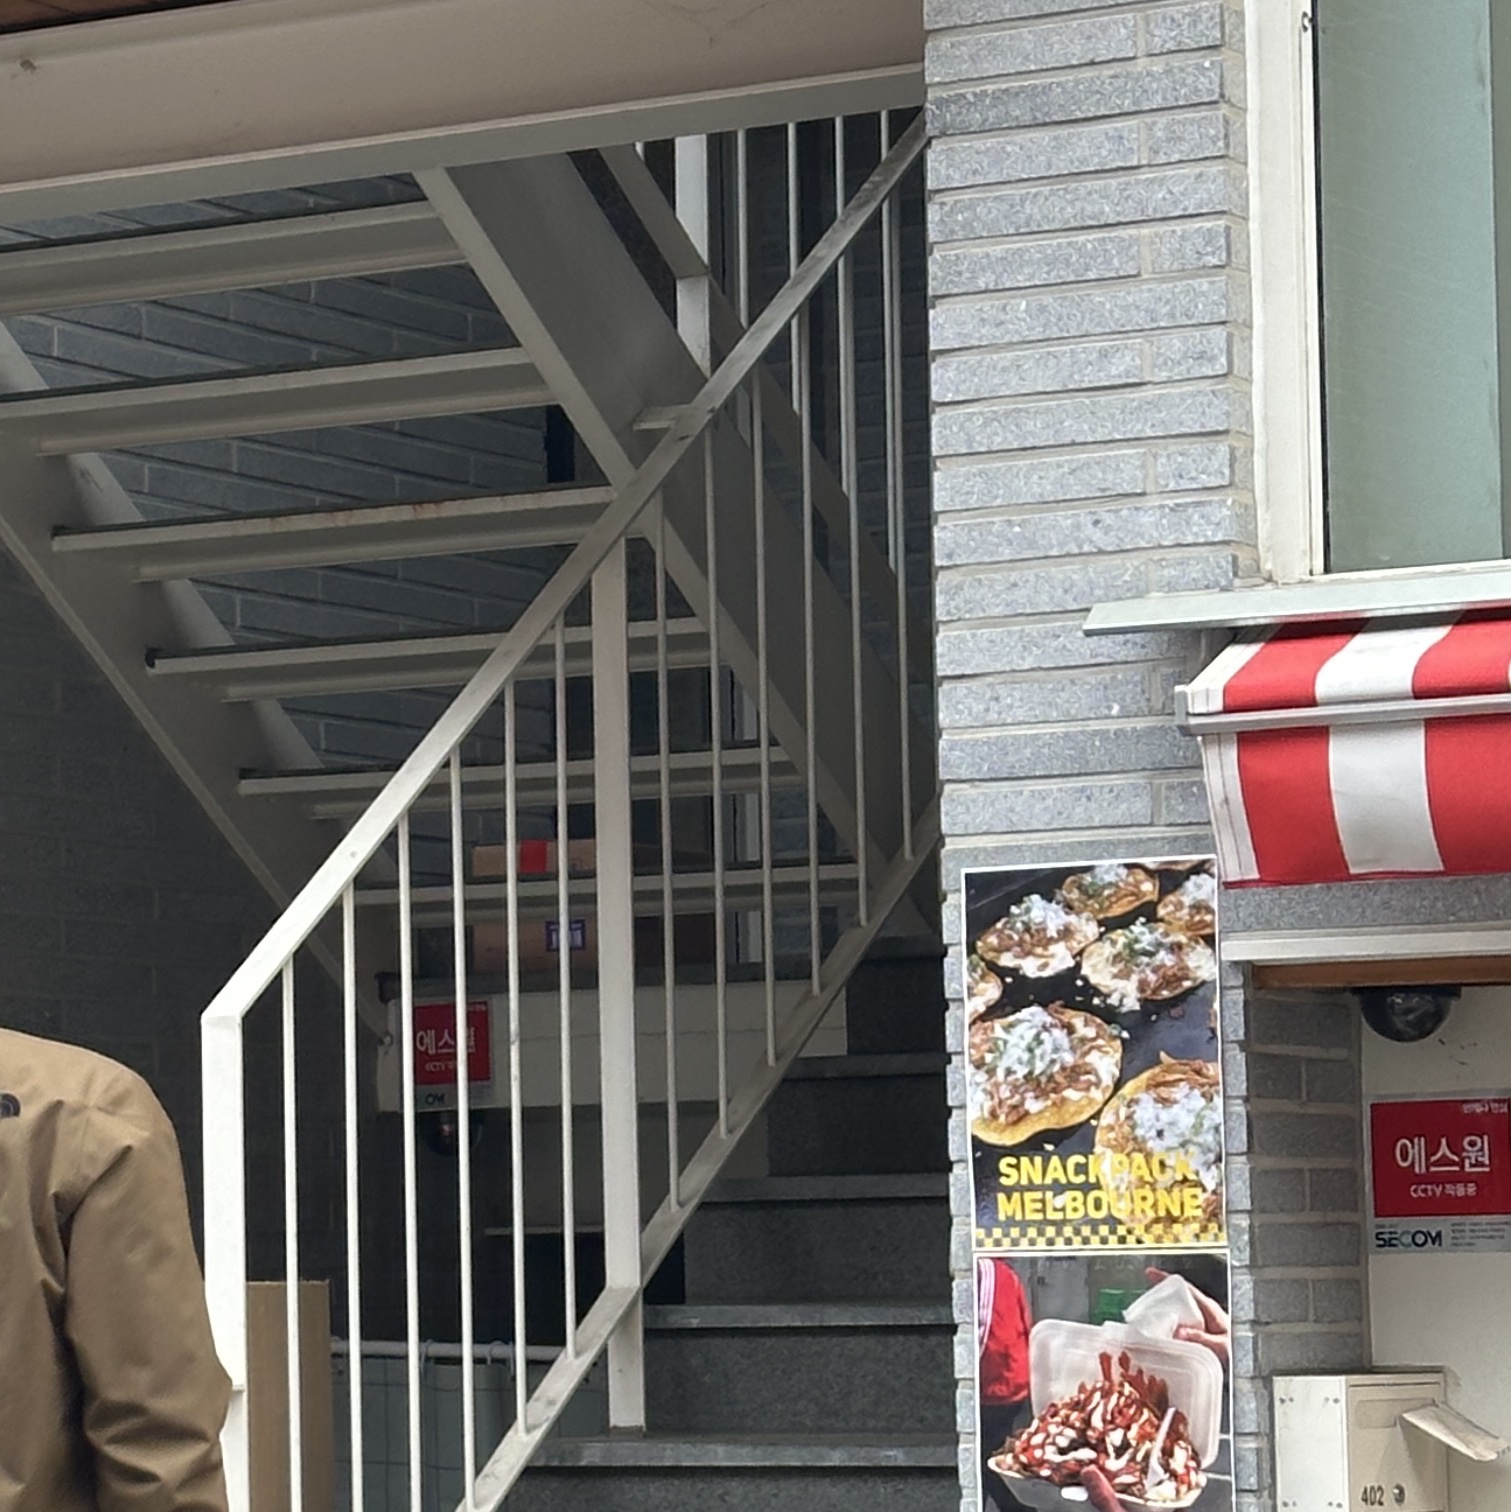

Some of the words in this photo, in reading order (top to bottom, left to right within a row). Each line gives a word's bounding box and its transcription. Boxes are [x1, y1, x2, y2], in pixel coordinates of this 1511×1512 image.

[1395, 1134, 1490, 1174] 에스원
[999, 1152, 1199, 1187] SNACKPACK
[1410, 1183, 1443, 1198] CCTV
[997, 1188, 1204, 1222] MELBOURNE
[1375, 1230, 1442, 1249] SECOM
[1361, 1484, 1385, 1507] 402
